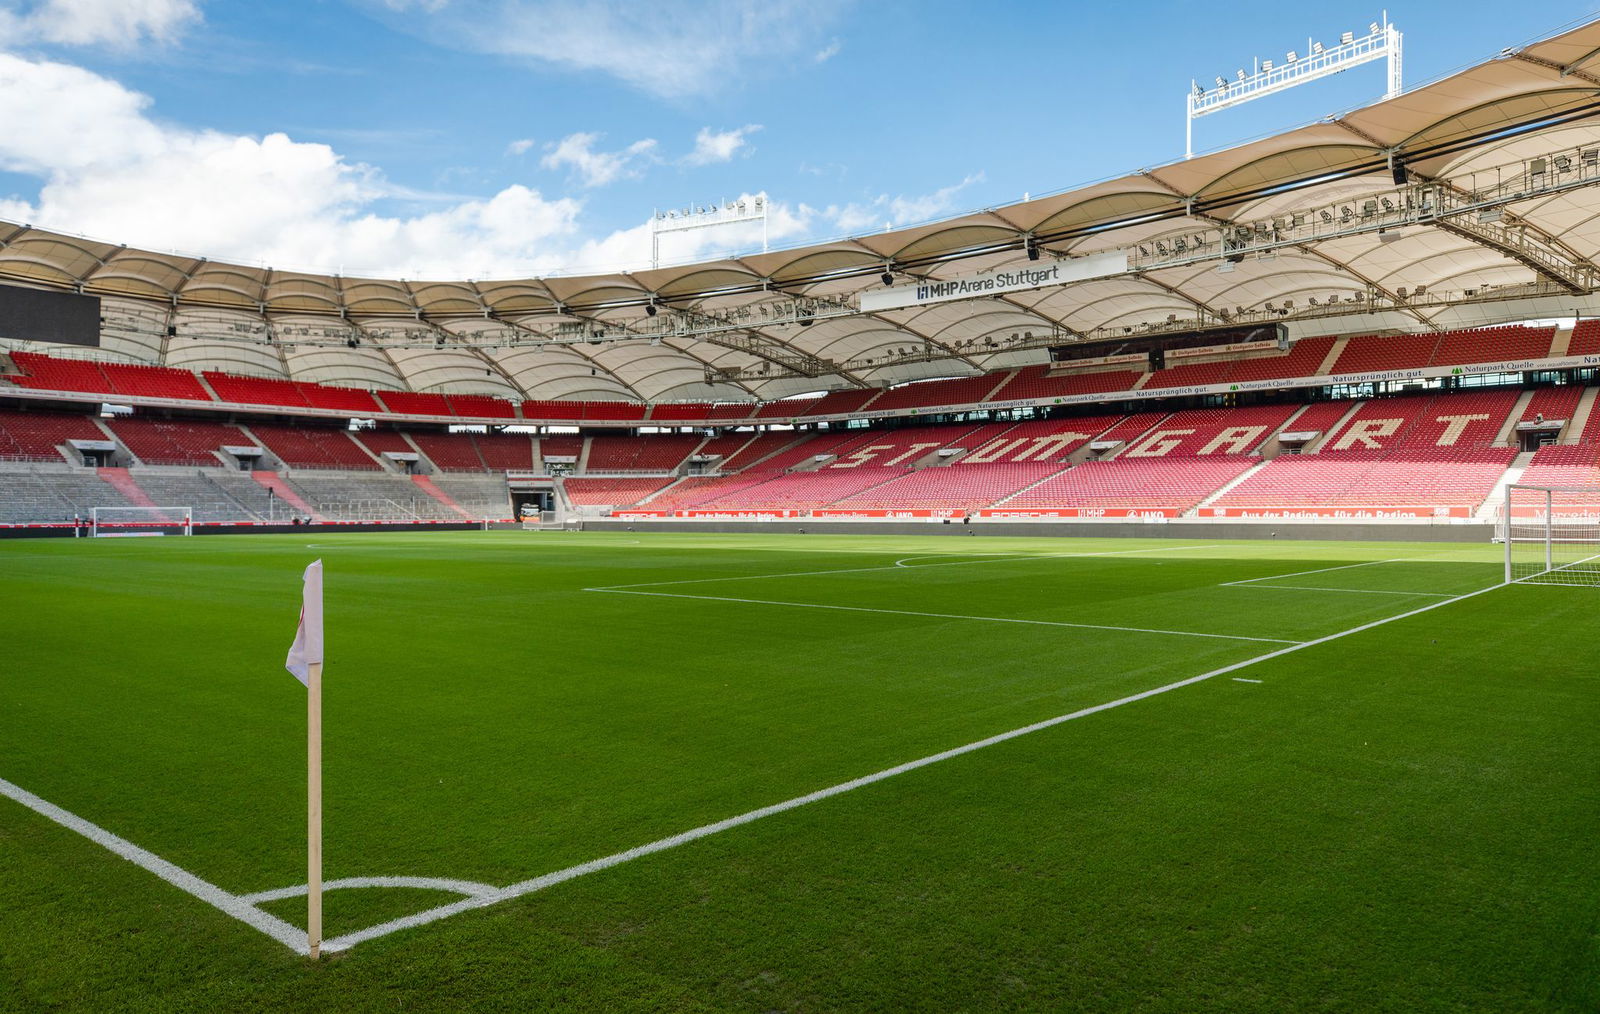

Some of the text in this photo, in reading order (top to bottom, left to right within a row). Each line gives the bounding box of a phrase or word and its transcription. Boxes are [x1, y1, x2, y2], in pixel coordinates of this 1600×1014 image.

[996, 265, 1059, 288] Stuttgart
[1465, 363, 1506, 373] Naturpark
[1506, 361, 1535, 370] Quelle
[1332, 369, 1425, 383] Natursprünglich gut.
[1240, 381, 1272, 389] Naturpark
[1272, 379, 1295, 387] Quelle
[1135, 386, 1209, 398] Natursprünglich gut.
[1062, 394, 1089, 403] Naturpark
[977, 400, 1025, 409] Natursprünglich
[847, 410, 886, 418] Natursprünglich
[938, 509, 954, 517] MHP
[1086, 509, 1106, 517] MHP
[1241, 510, 1261, 518] Aus
[1262, 510, 1281, 518] der
[1282, 510, 1319, 519] Region
[1334, 510, 1353, 518] für
[1354, 510, 1373, 518] die
[1376, 510, 1416, 519] Region
